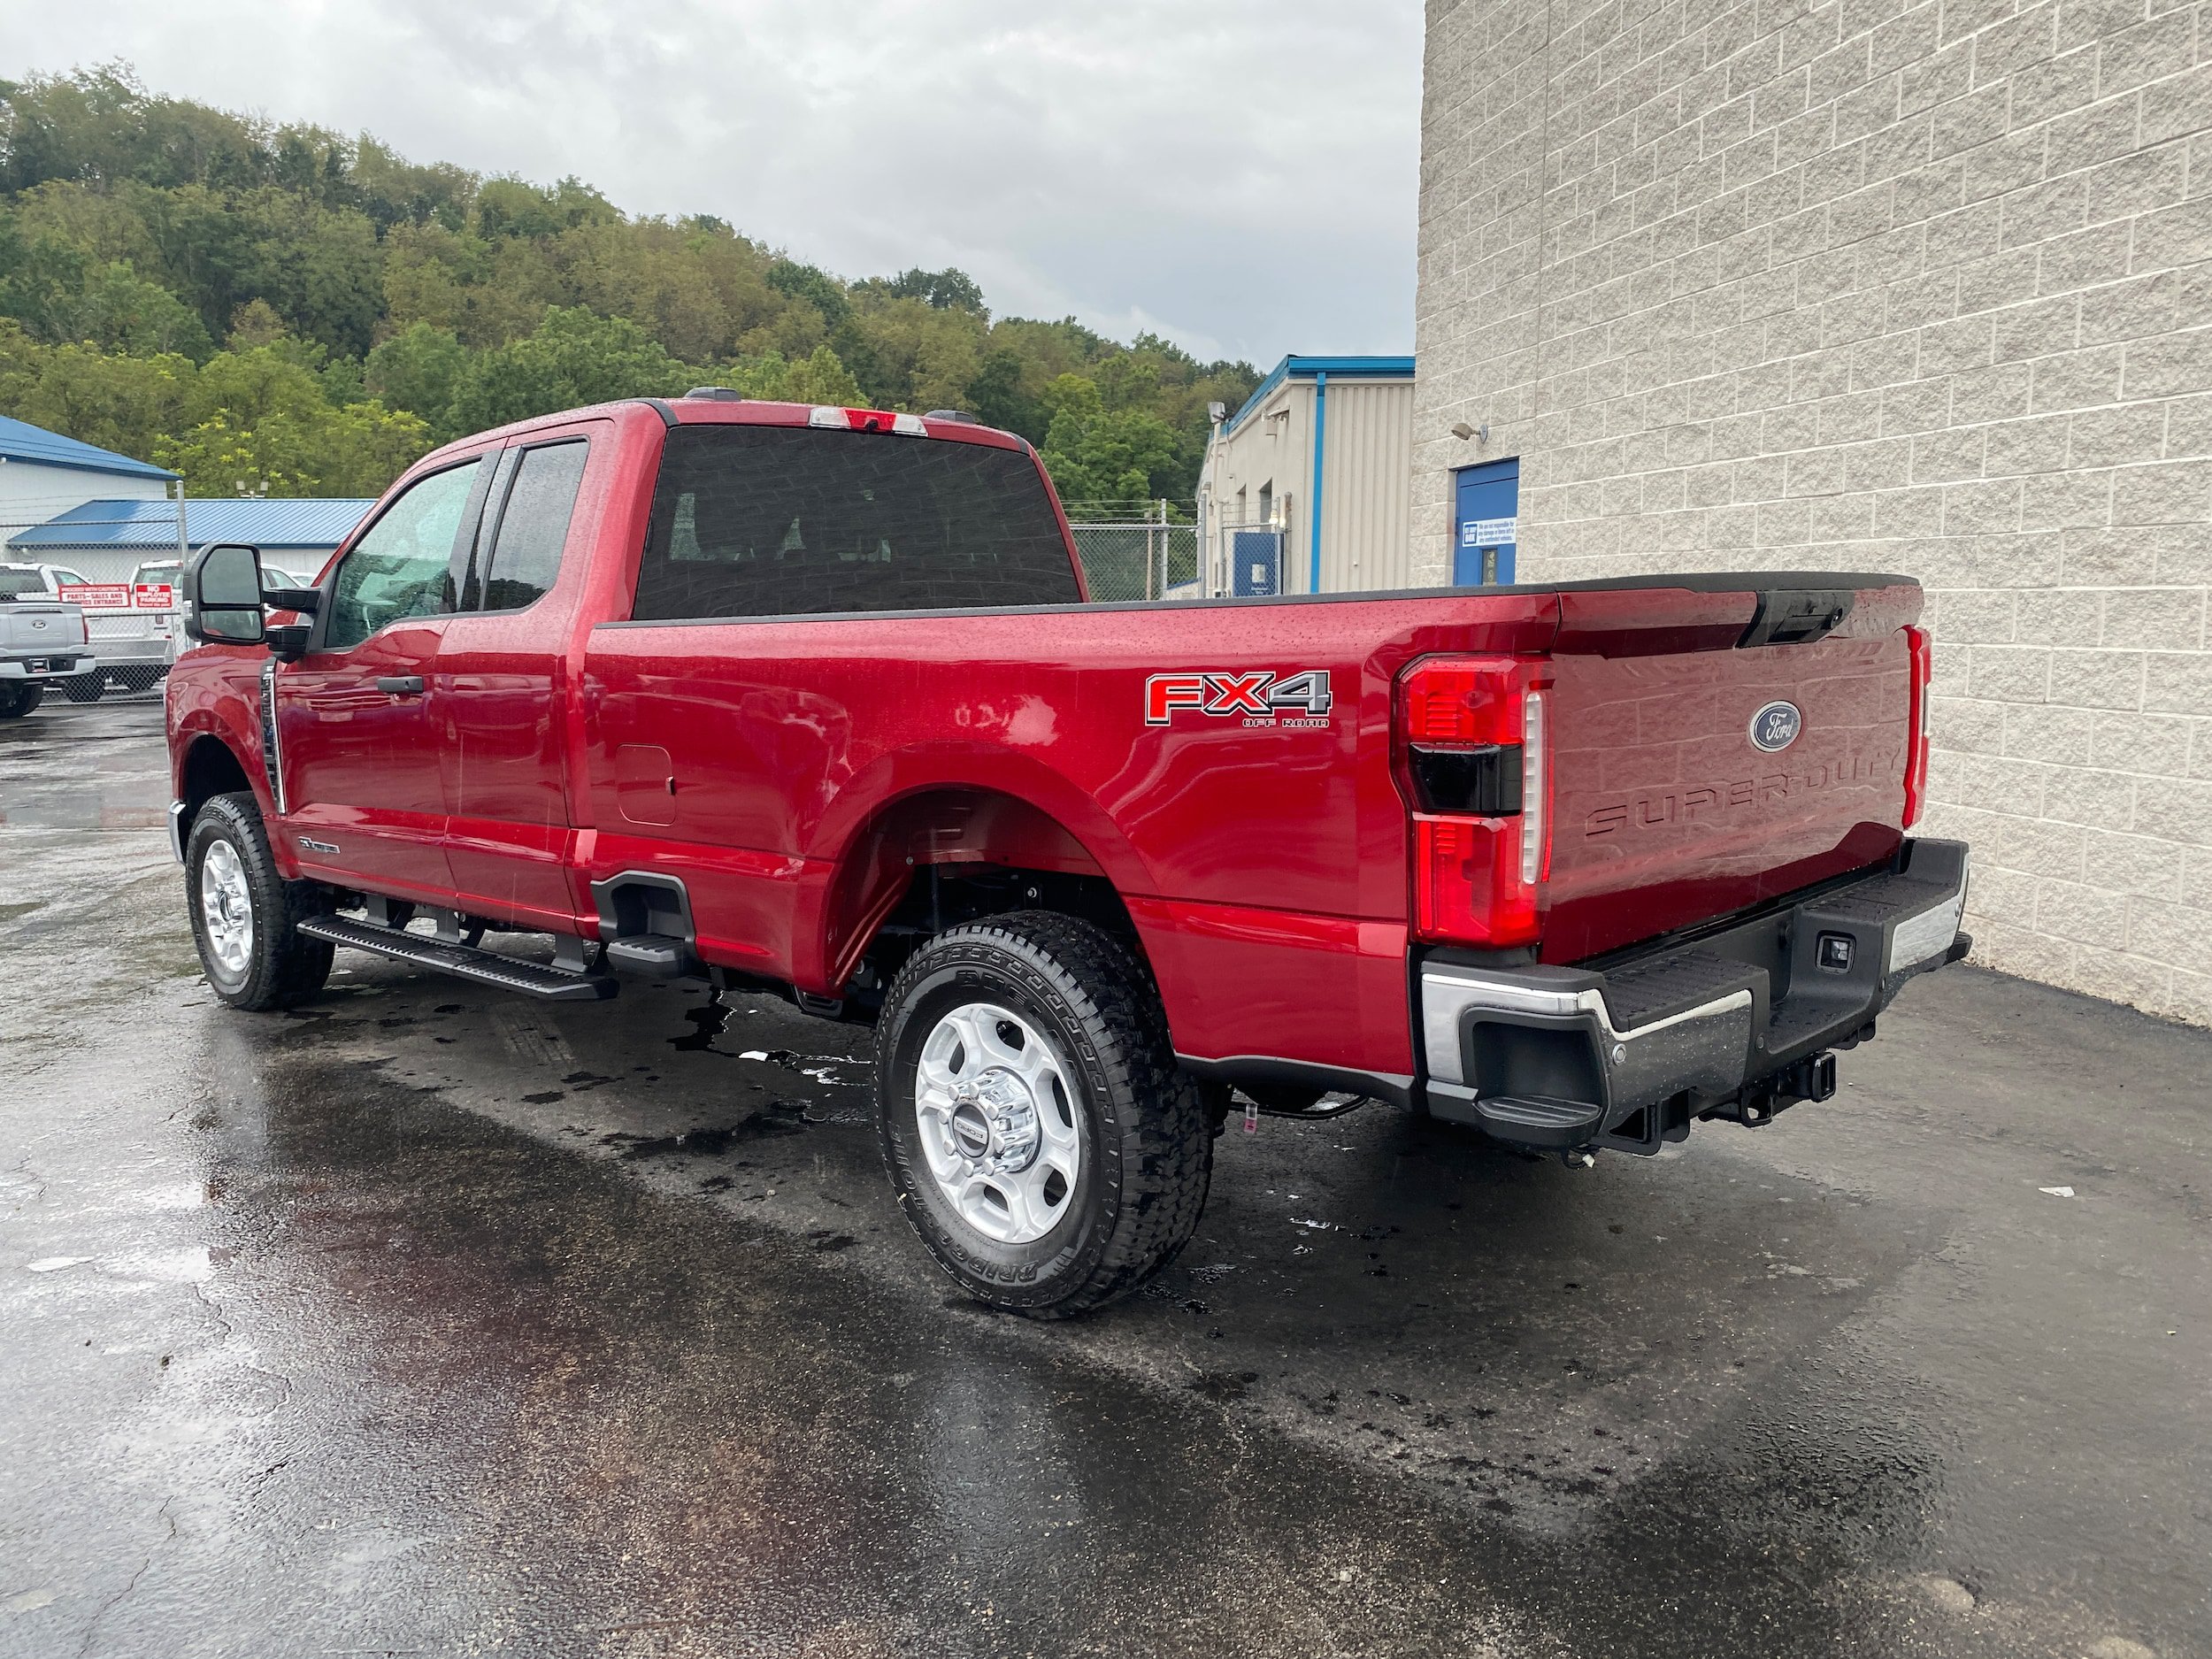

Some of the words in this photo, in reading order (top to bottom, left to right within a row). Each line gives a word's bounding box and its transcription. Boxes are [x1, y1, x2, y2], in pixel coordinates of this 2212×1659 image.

[1146, 671, 1333, 726] FX4
[1242, 718, 1277, 727] OFF
[1283, 718, 1330, 728] ROAD
[1766, 712, 1793, 741] Ford
[956, 1122, 984, 1139] FORD
